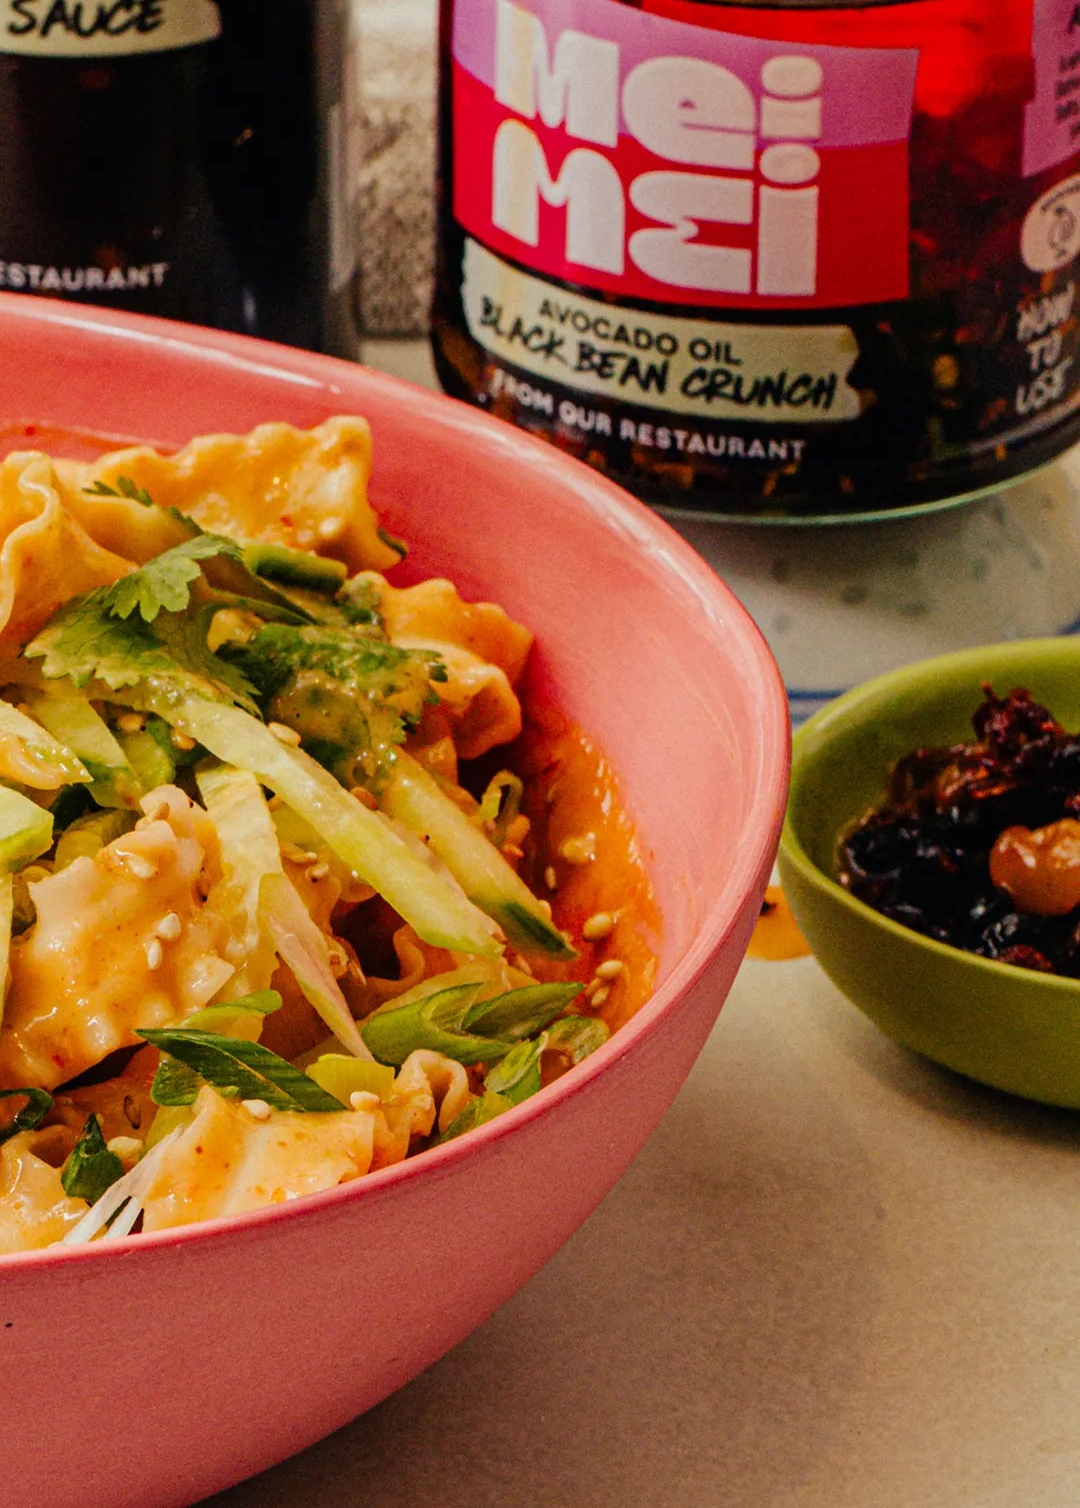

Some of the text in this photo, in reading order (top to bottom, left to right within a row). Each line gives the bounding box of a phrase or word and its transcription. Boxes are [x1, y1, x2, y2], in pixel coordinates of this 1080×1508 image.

[480, 295, 838, 412] BLACK BEAN CRUNCH
[539, 298, 743, 367] AVOCADO OIL
[489, 367, 808, 462] FROM OUR RESTAURANT
